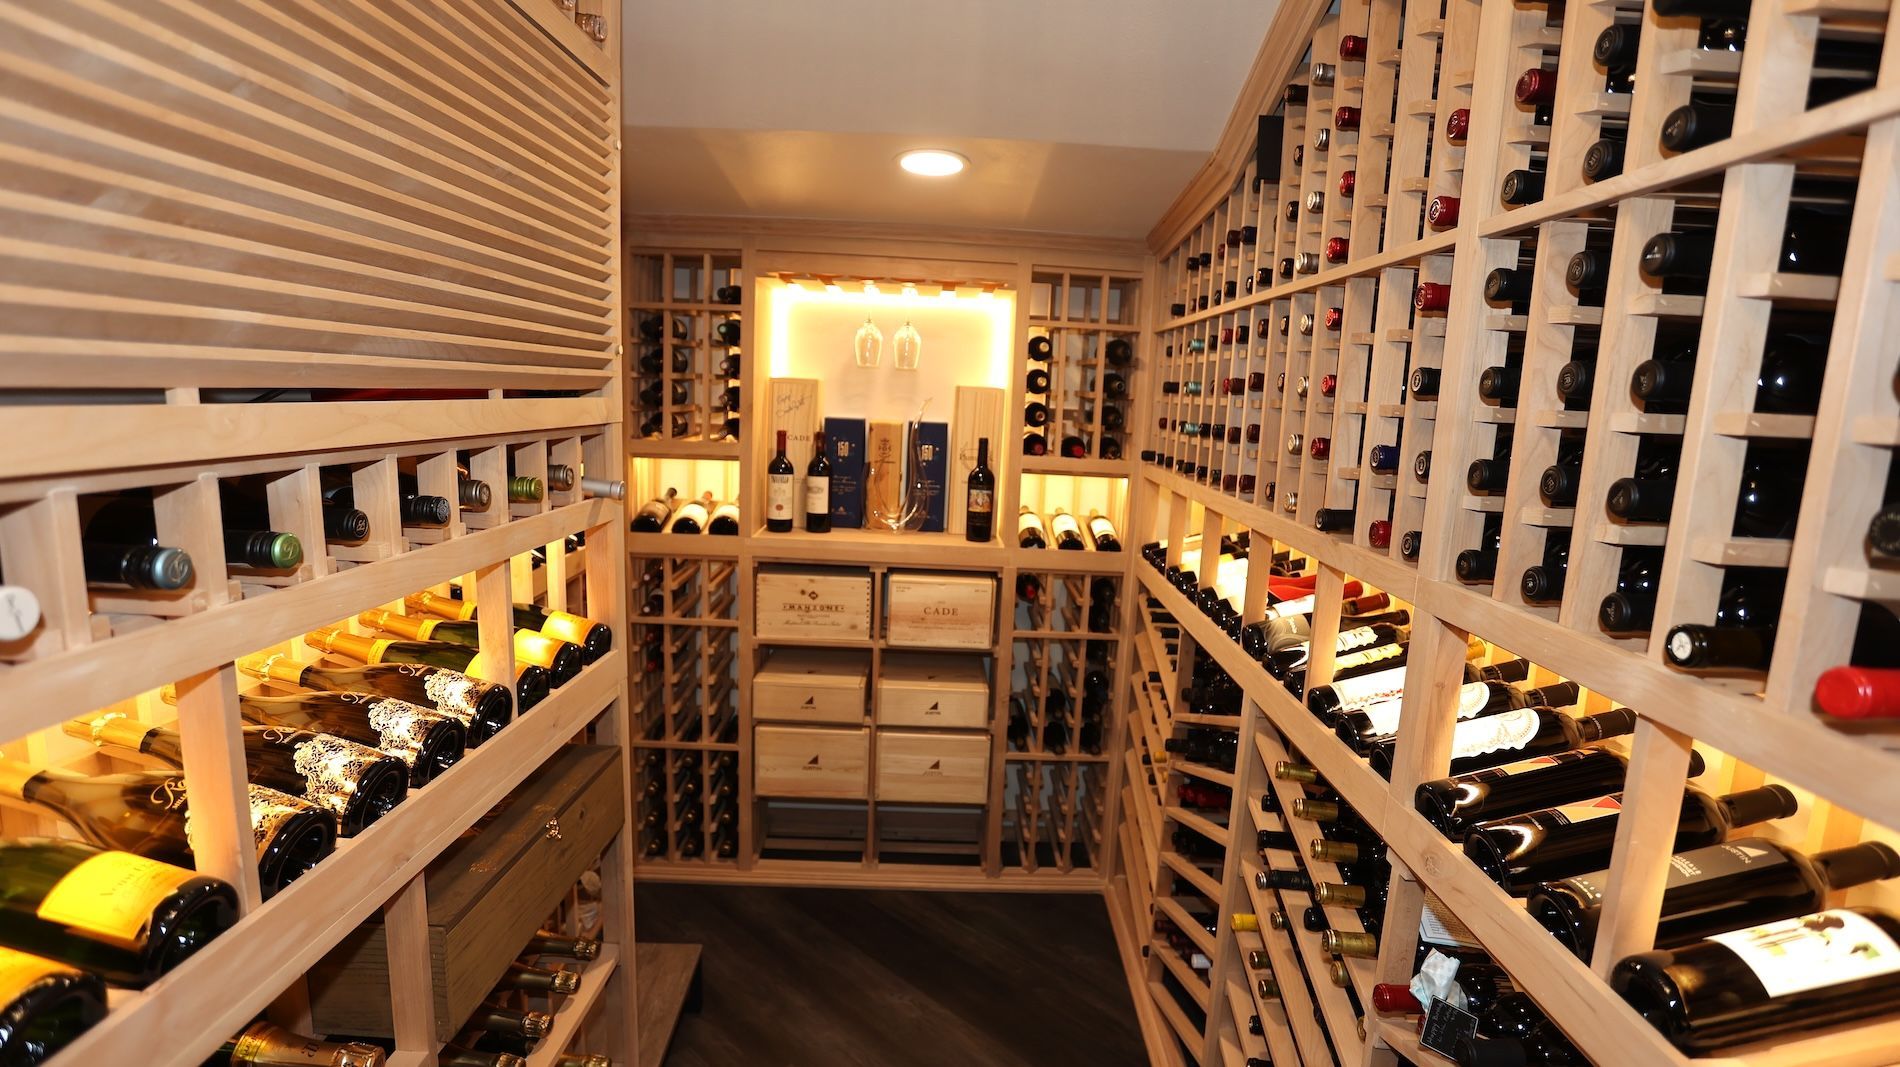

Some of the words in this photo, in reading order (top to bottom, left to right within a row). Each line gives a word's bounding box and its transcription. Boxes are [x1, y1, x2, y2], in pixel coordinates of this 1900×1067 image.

[787, 434, 810, 442] CADE
[837, 441, 849, 457] 150
[923, 606, 959, 617] CADE
